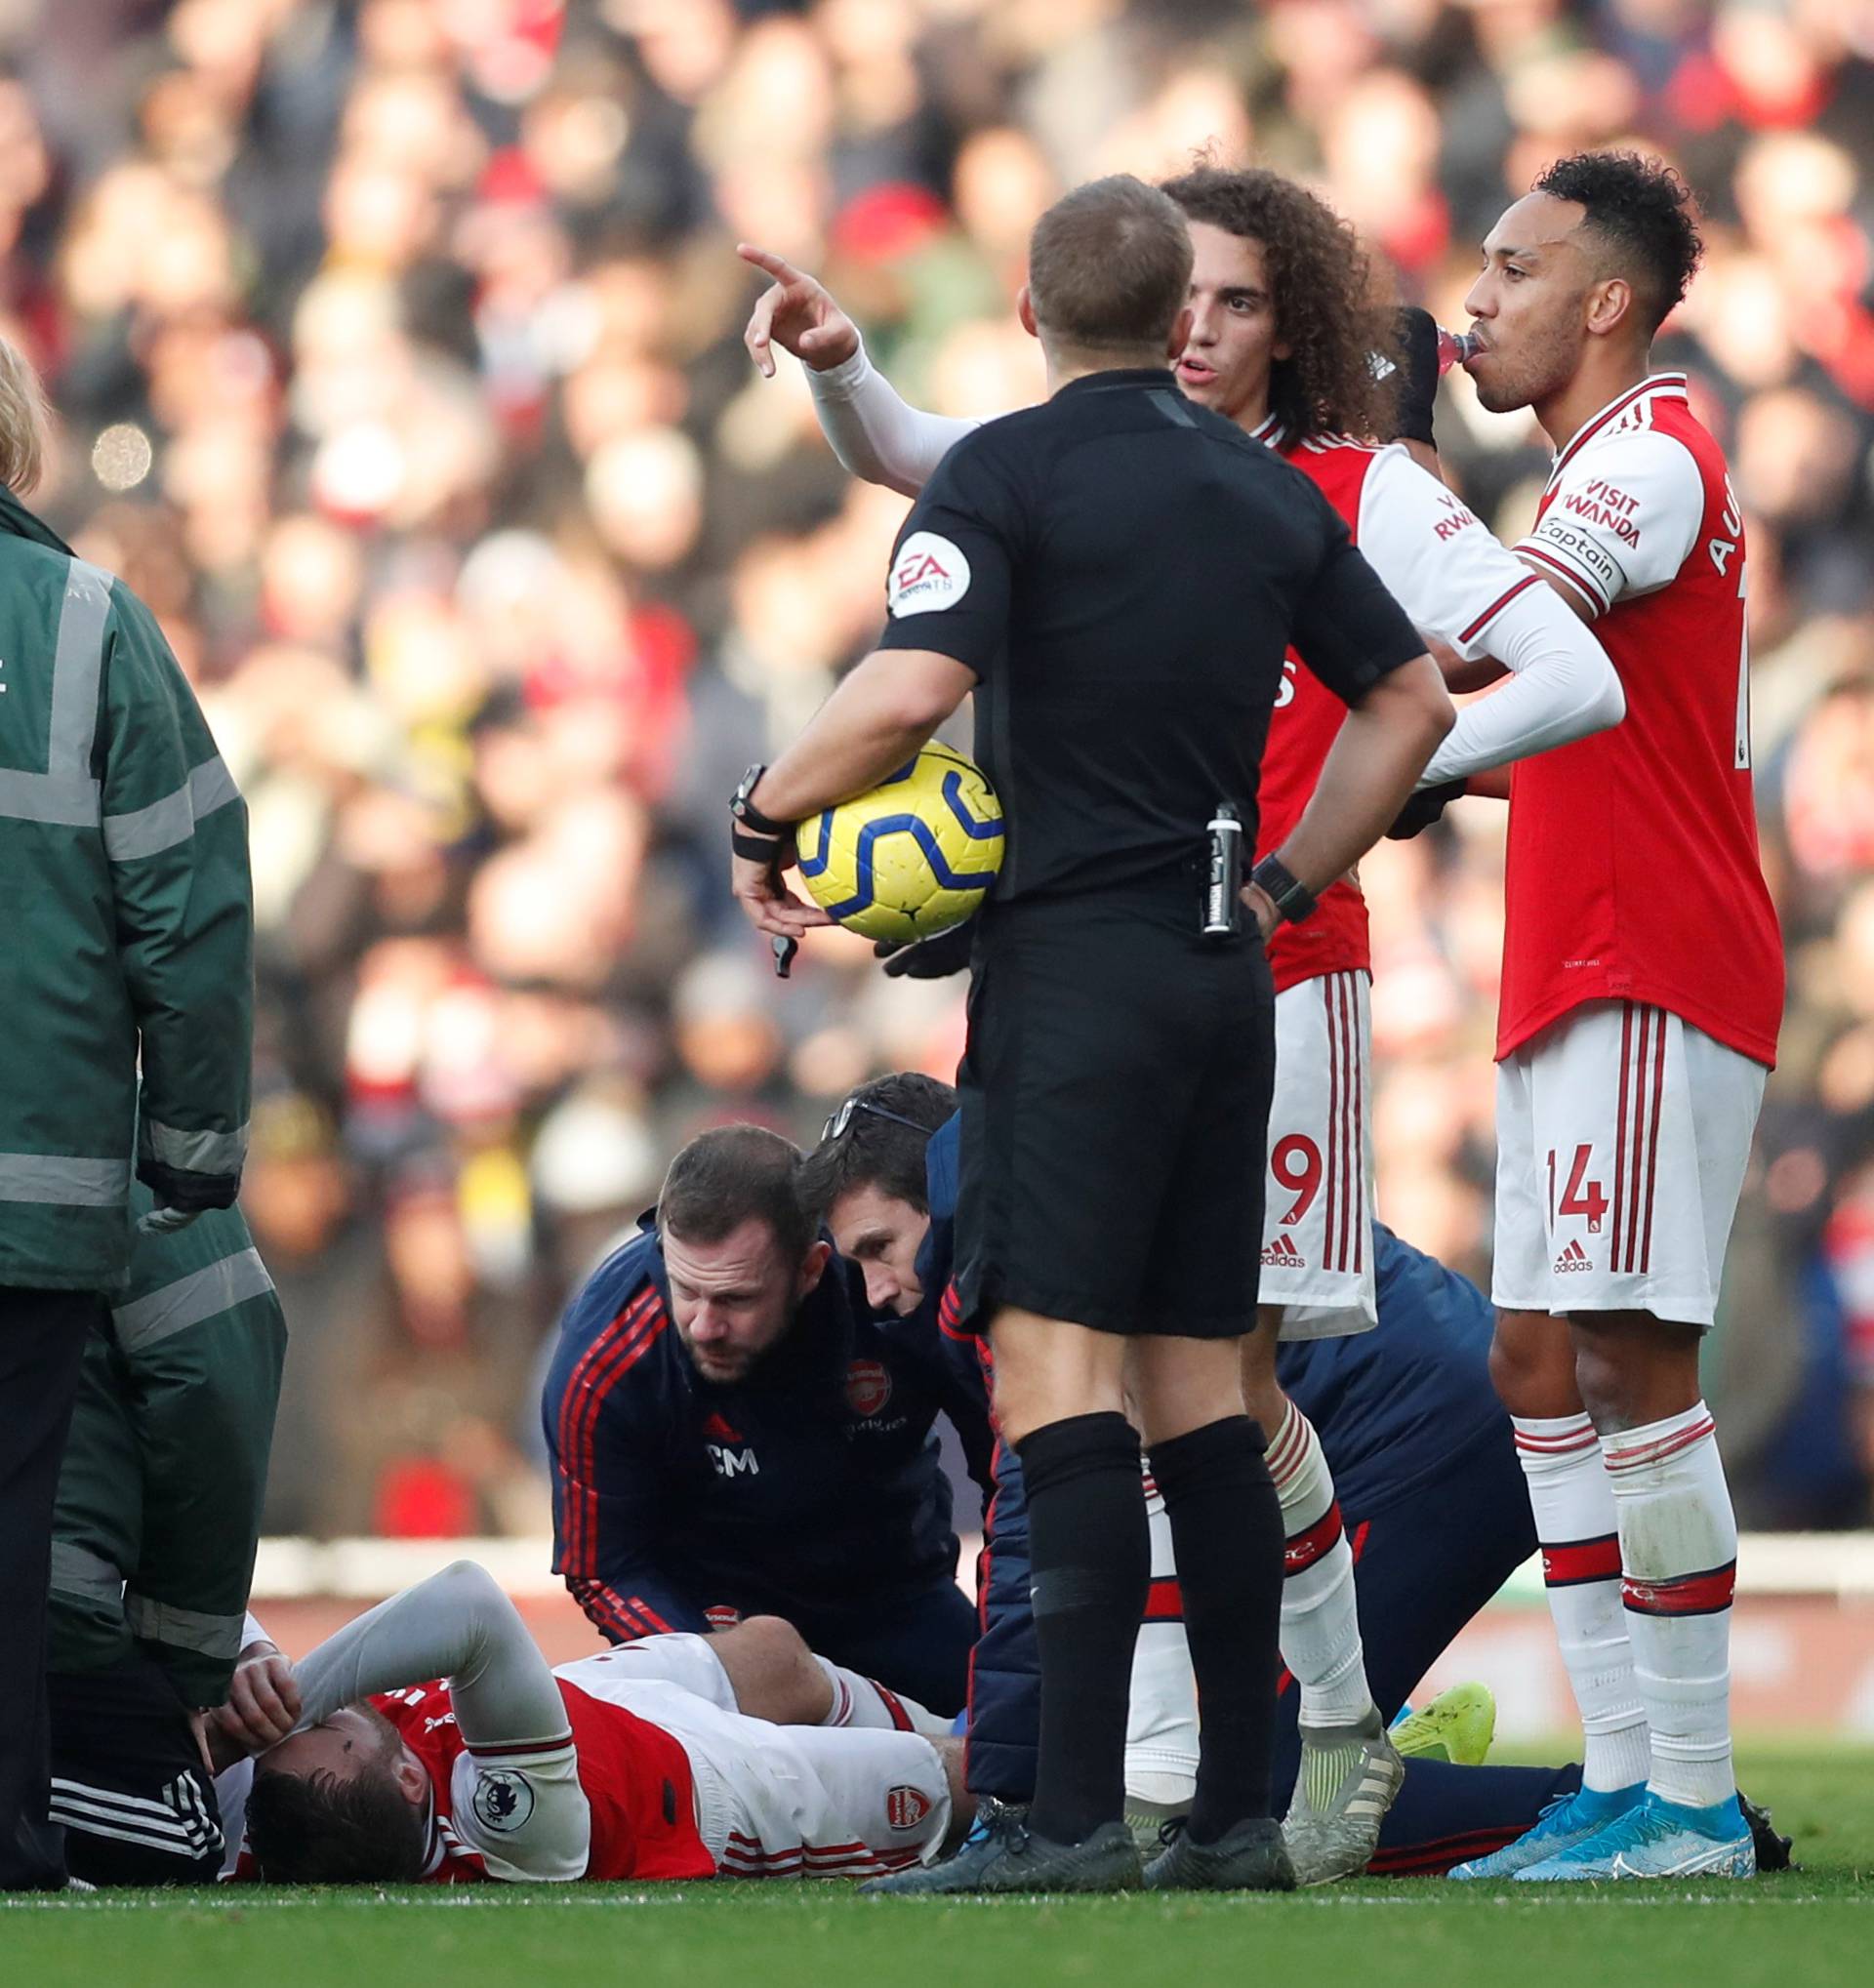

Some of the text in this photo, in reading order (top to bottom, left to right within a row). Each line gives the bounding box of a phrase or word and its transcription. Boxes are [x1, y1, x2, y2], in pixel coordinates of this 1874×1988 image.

[1587, 479, 1641, 516] VISIT
[1563, 493, 1641, 549] WANDA
[1540, 520, 1613, 581] Captain
[898, 552, 950, 590] EA
[1271, 1132, 1324, 1226] 9
[1546, 1143, 1610, 1238] 14
[1259, 1253, 1306, 1269] adidas
[1553, 1260, 1594, 1274] adidas
[707, 1444, 759, 1478] CM
